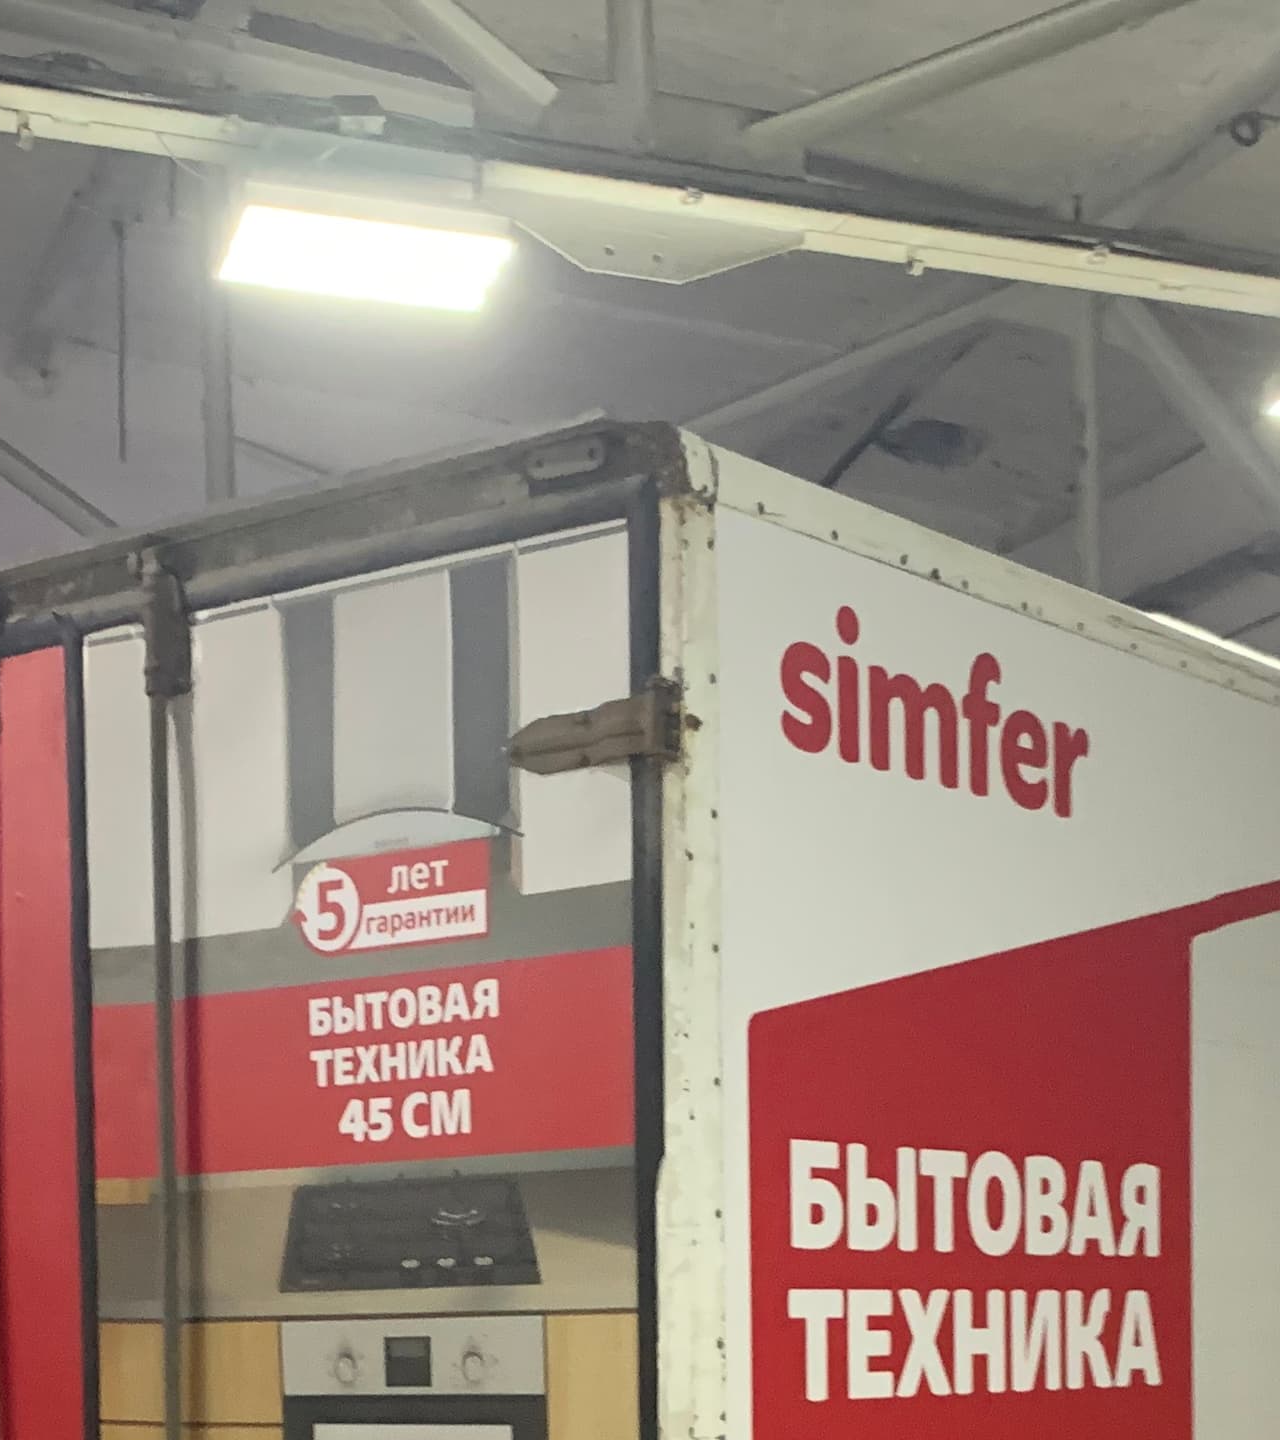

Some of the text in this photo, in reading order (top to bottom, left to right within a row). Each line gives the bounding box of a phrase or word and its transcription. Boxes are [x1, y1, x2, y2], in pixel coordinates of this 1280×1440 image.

[780, 605, 1089, 818] simfer
[387, 859, 449, 894] лет
[317, 878, 346, 941] 5
[365, 902, 476, 938] гарантии
[308, 978, 501, 1036] БЫТОВАЯ
[309, 1033, 495, 1088] ТЕХНИКА
[337, 1088, 472, 1143] 45 СМ
[789, 1138, 1162, 1258] БЫТОВАЯ
[787, 1288, 1163, 1402] ТЕХНИКА
